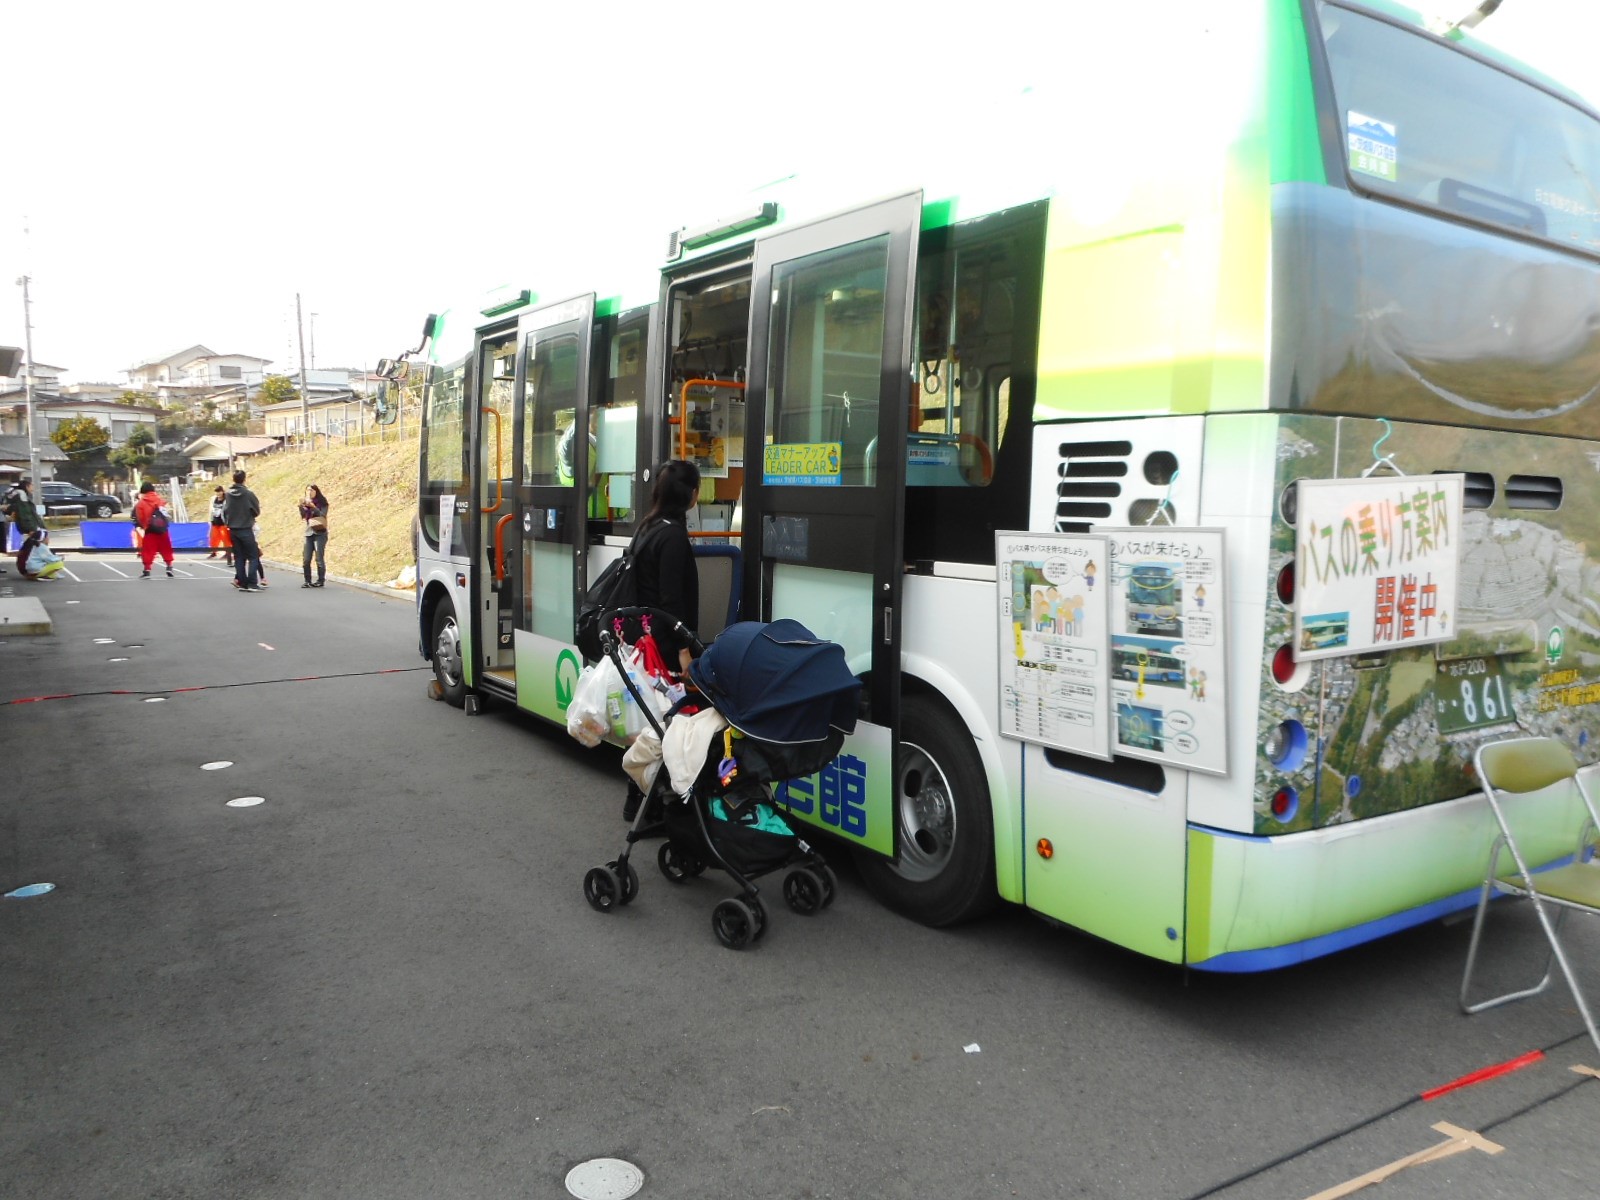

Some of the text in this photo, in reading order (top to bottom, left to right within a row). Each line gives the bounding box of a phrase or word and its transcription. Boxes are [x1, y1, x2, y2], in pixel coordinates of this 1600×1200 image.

[765, 446, 827, 461] 交通マナーアップ
[765, 460, 826, 474] LEADER CAR
[1302, 481, 1449, 590] バスの乗り方案内
[1373, 572, 1438, 644] 開催中
